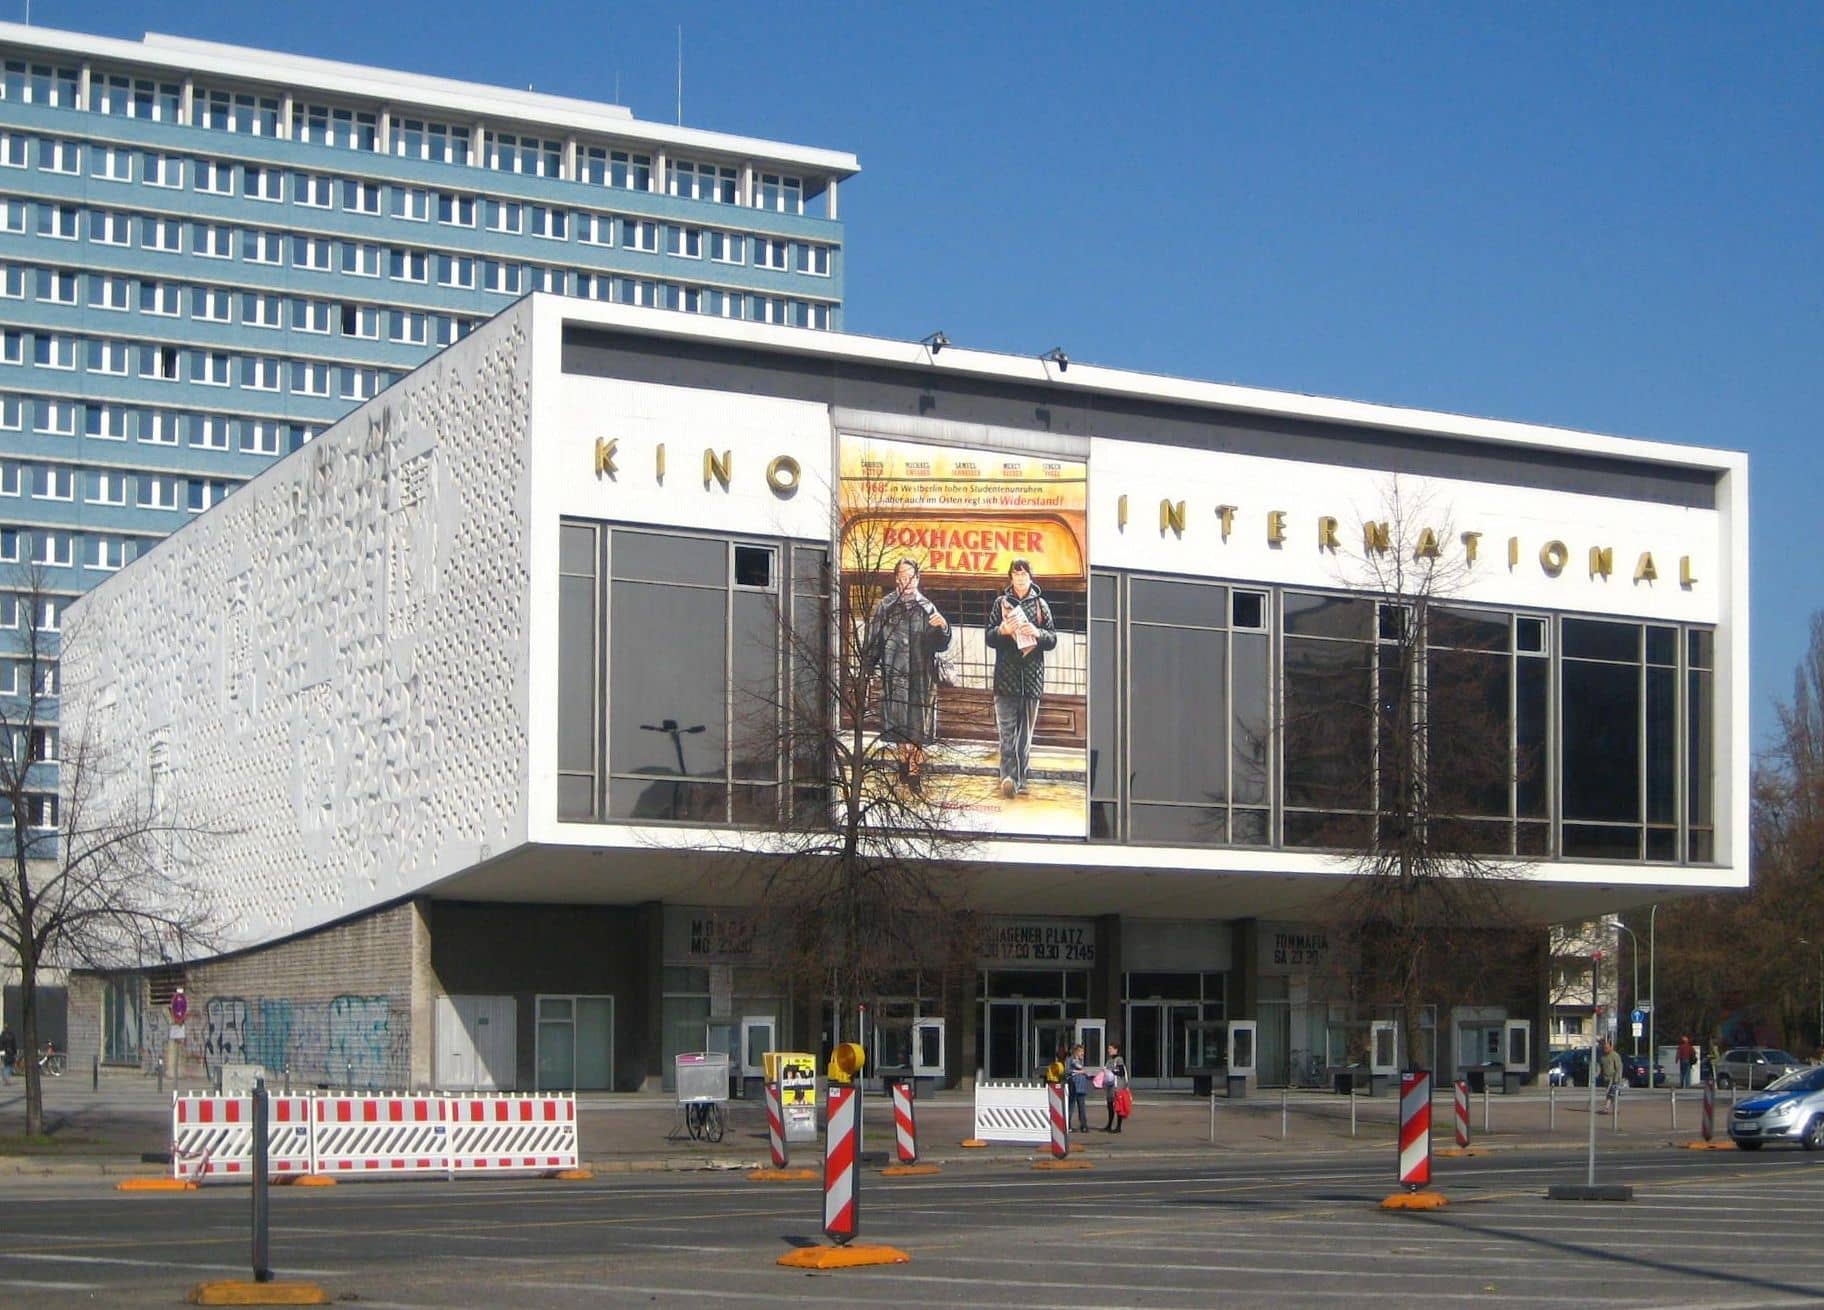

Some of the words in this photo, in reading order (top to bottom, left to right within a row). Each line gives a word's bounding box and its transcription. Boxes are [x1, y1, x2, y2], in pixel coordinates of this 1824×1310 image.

[901, 484, 942, 493] Westberlin
[970, 484, 1043, 494] Studentenunruhen
[939, 495, 963, 504] Osten
[595, 436, 802, 494] KINO
[1117, 494, 1698, 589] INTERNATIONAL
[884, 527, 1045, 553] BOXHAGENER
[929, 551, 999, 572] PLATZ
[1045, 928, 1084, 945] PLATZ
